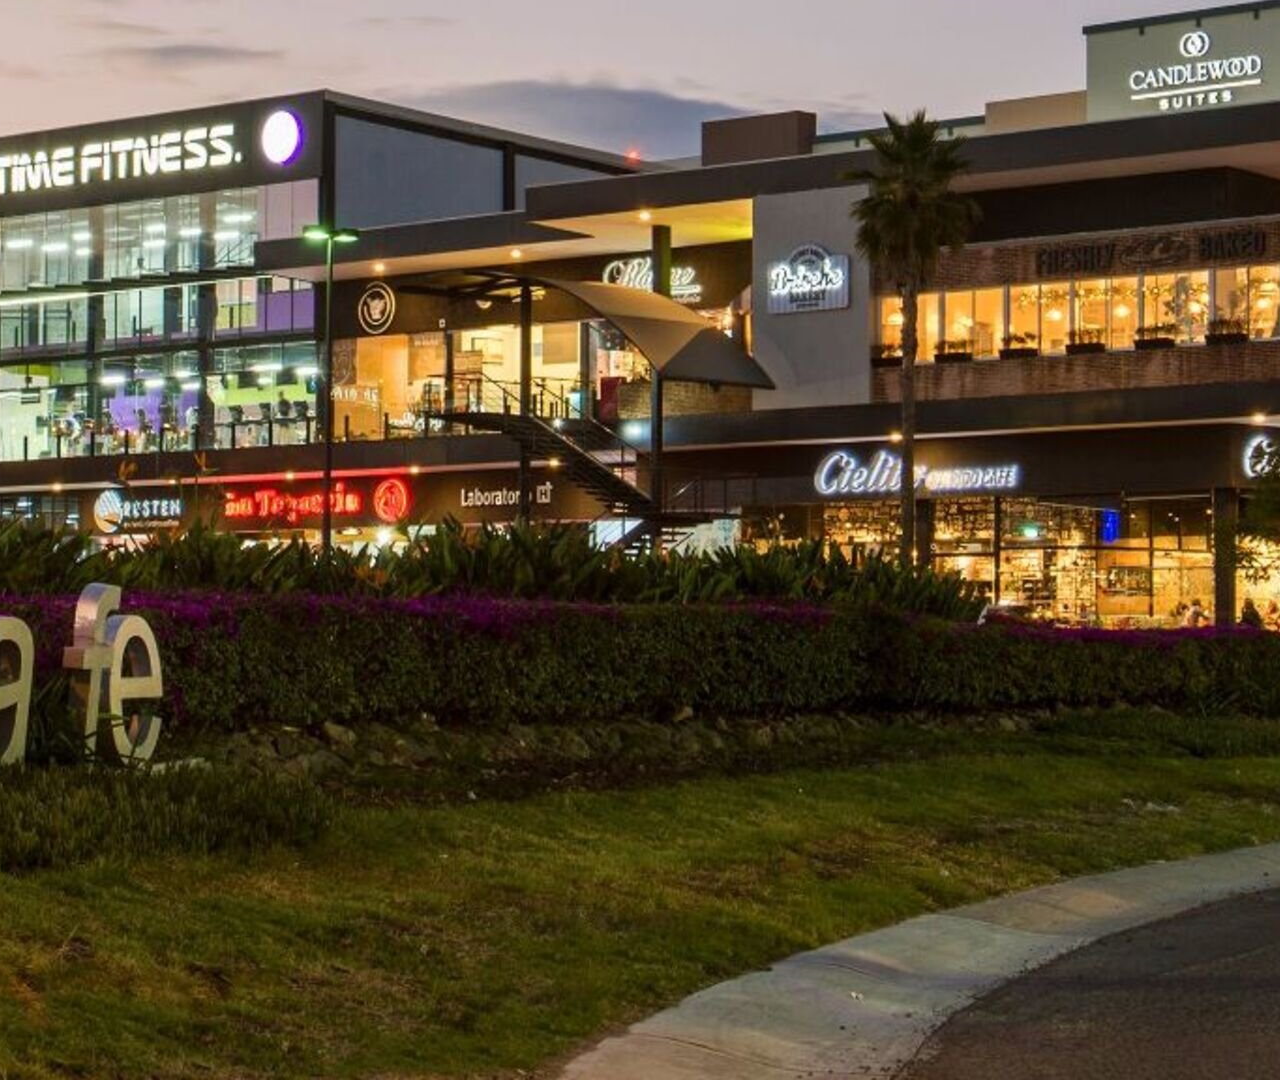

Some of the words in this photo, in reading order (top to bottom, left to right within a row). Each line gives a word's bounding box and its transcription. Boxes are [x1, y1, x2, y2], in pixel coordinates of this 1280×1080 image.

[1129, 55, 1263, 91] CANDLEWOOD
[1158, 89, 1233, 111] SUITES
[63, 583, 163, 763] fe
